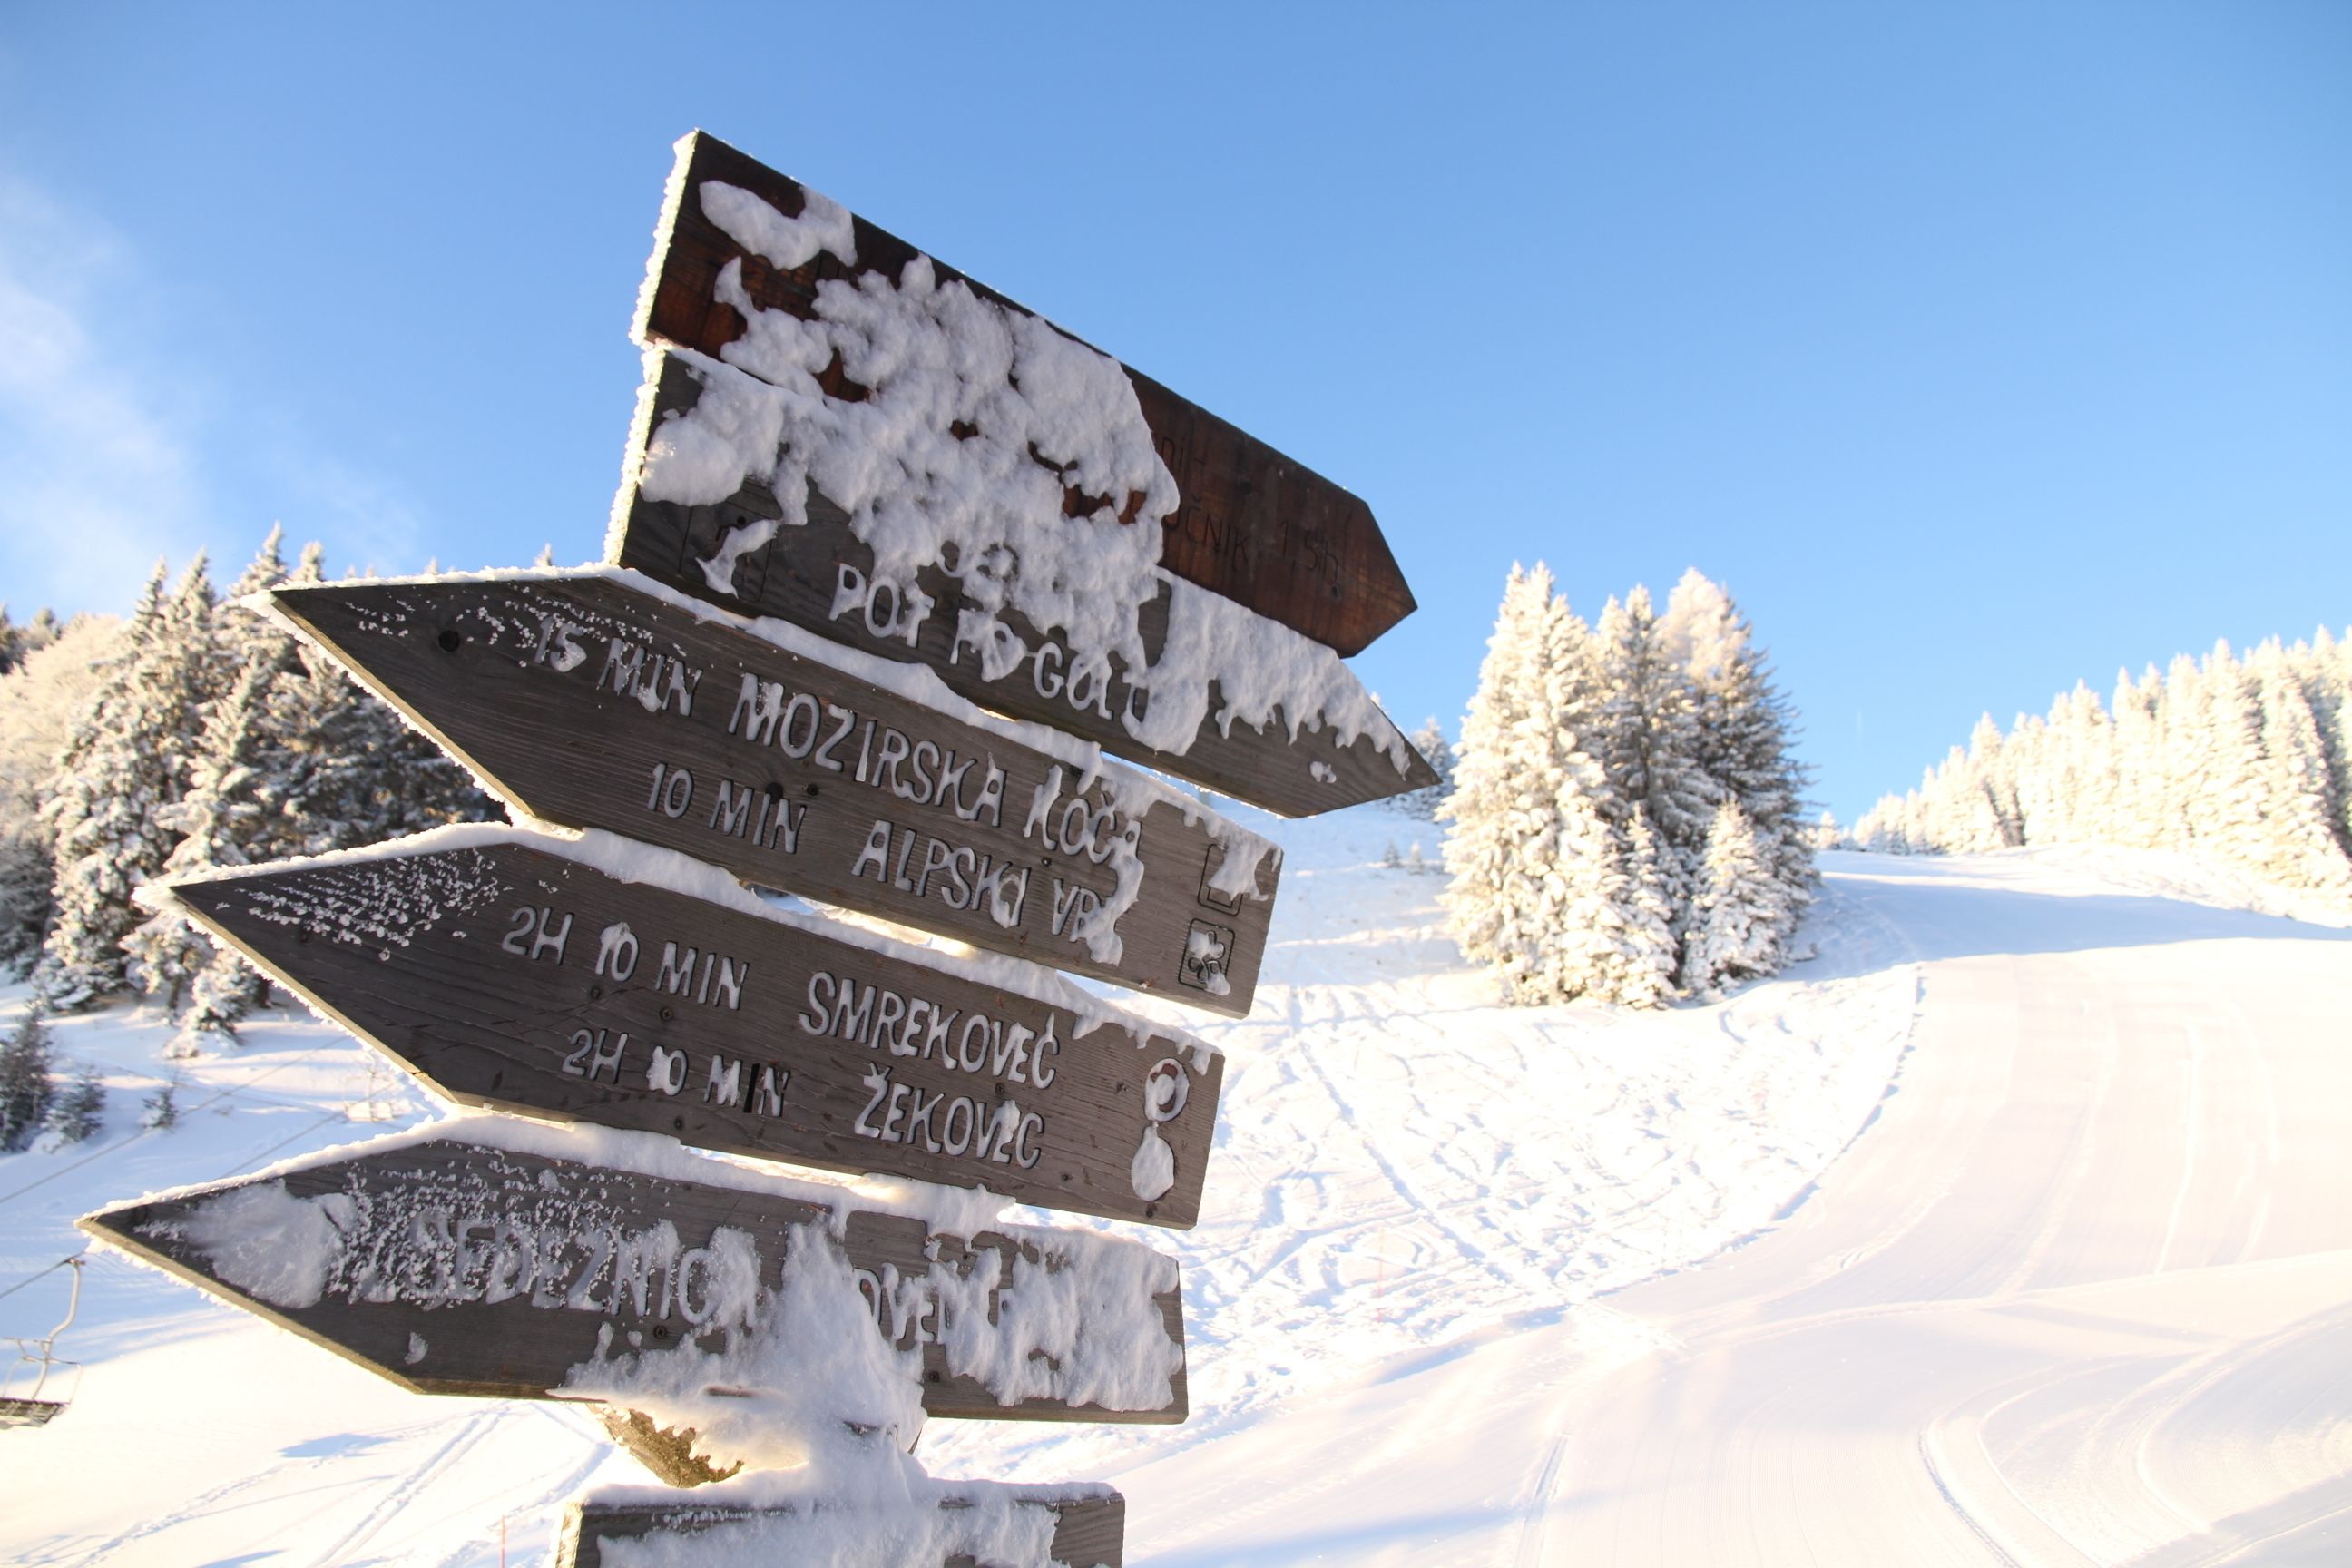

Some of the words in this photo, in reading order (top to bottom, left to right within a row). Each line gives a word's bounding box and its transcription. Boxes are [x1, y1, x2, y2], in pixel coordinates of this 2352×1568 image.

[534, 615, 587, 673] 15
[597, 637, 703, 717] MIN
[729, 672, 1007, 828] MOZIRSKA
[646, 761, 694, 818] 10
[709, 778, 807, 855] MIN
[850, 819, 1033, 927] ALPSKI
[501, 904, 576, 966] 2H
[594, 921, 641, 983] 10
[654, 940, 750, 1011] MIN
[561, 1027, 630, 1085] 2H
[703, 1054, 791, 1118] MIN
[854, 1061, 1045, 1170] ŽEKOVEC
